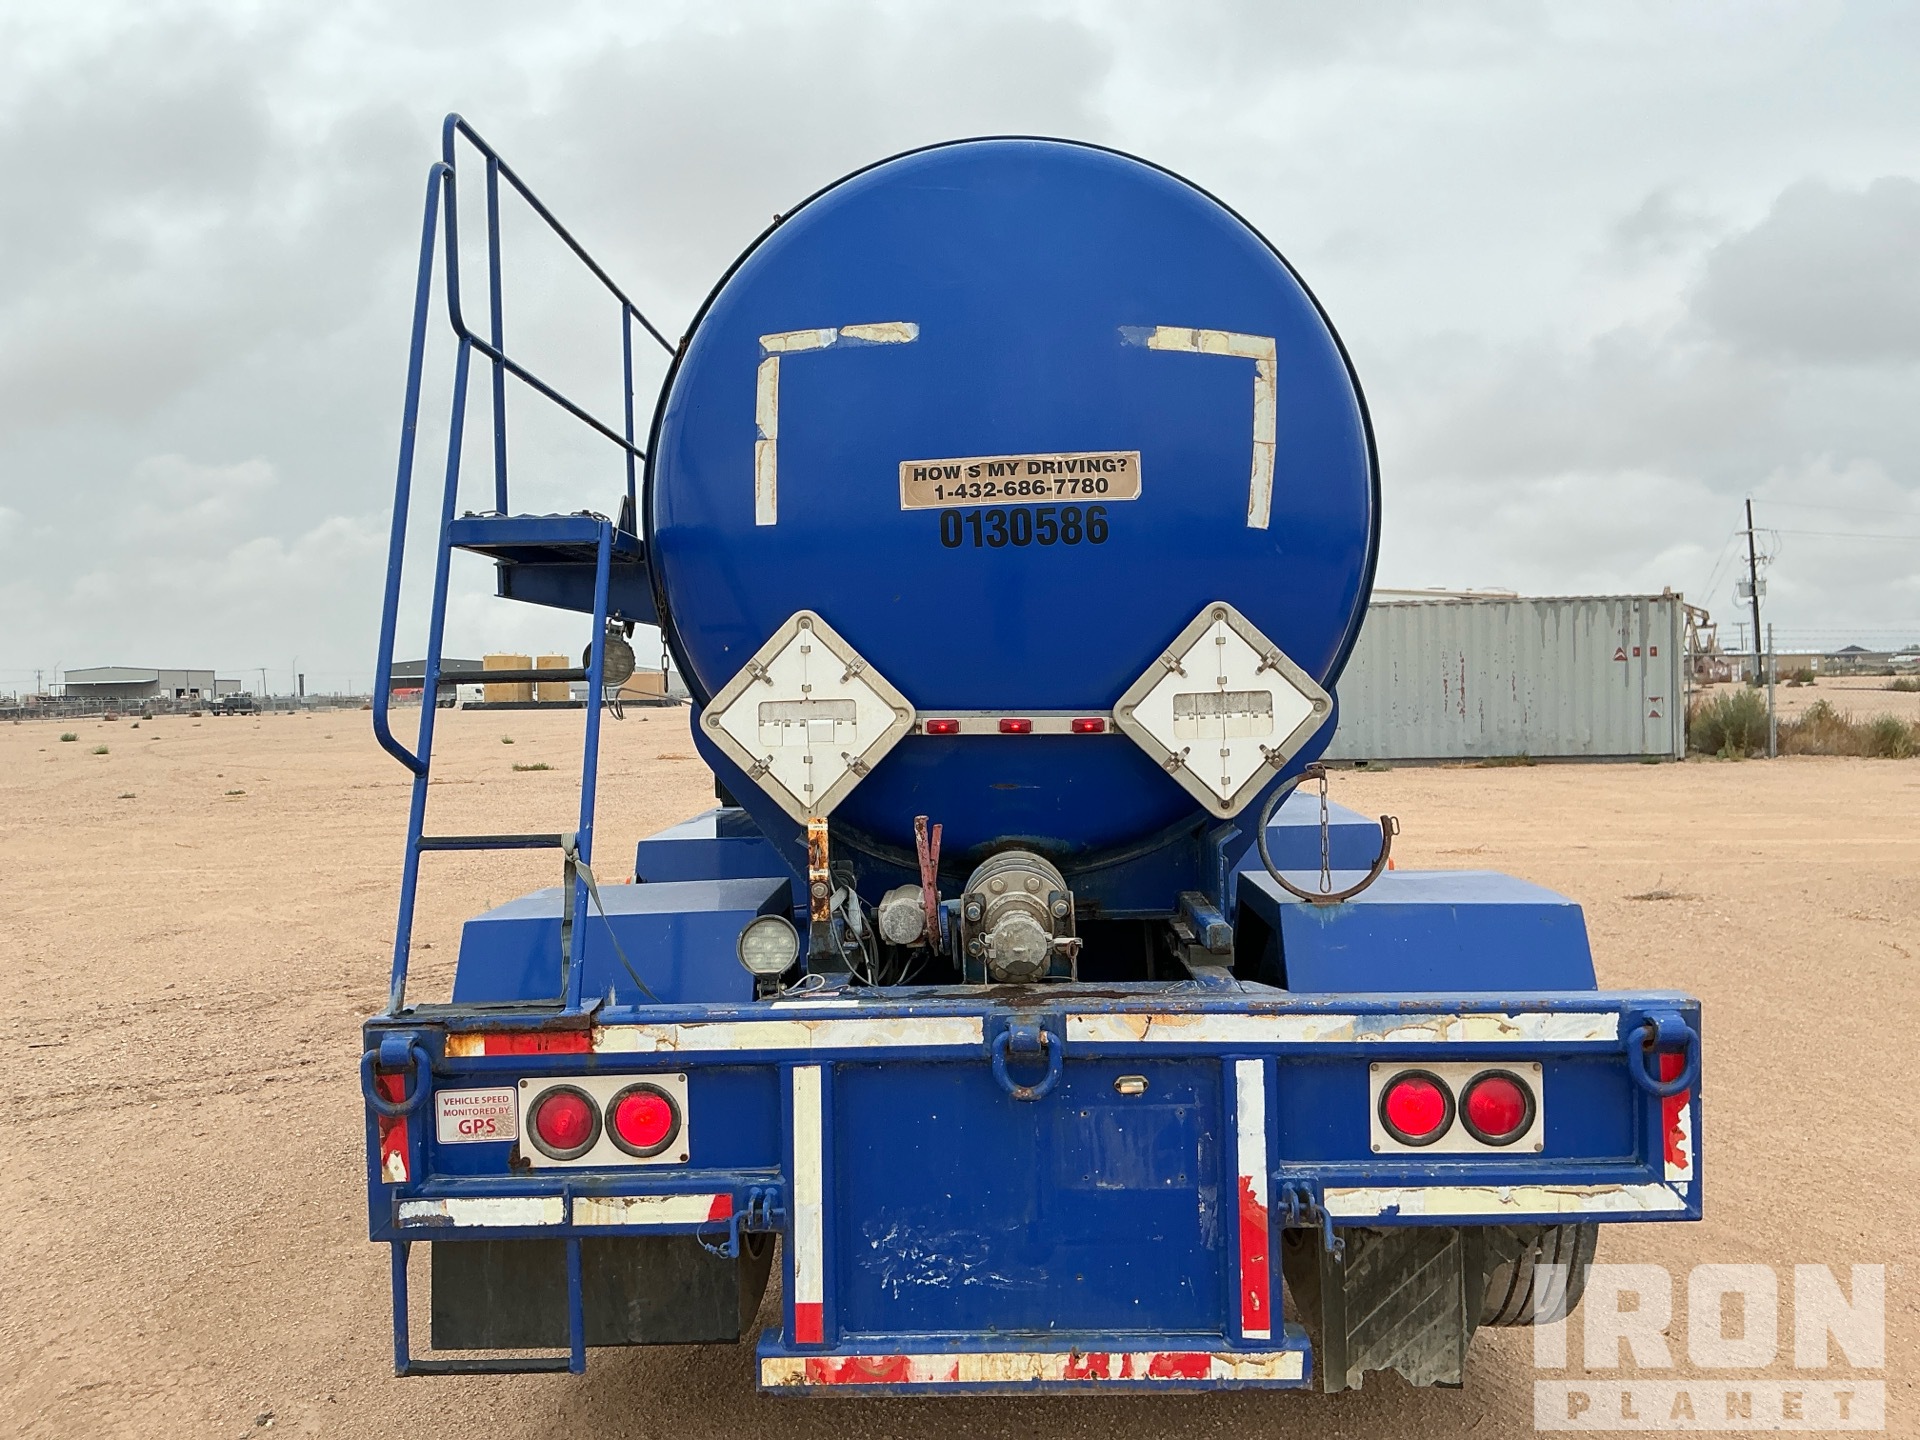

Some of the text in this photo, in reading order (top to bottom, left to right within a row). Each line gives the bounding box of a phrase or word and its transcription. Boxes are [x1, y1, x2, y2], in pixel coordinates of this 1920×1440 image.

[913, 459, 1127, 481] HOWS MY DRIVING?
[935, 479, 1109, 499] 1-432-686-7780
[940, 507, 1109, 548] 0130586
[443, 1097, 480, 1105] VEHICLE
[443, 1108, 497, 1116] MONITORED
[458, 1119, 496, 1135] GPS
